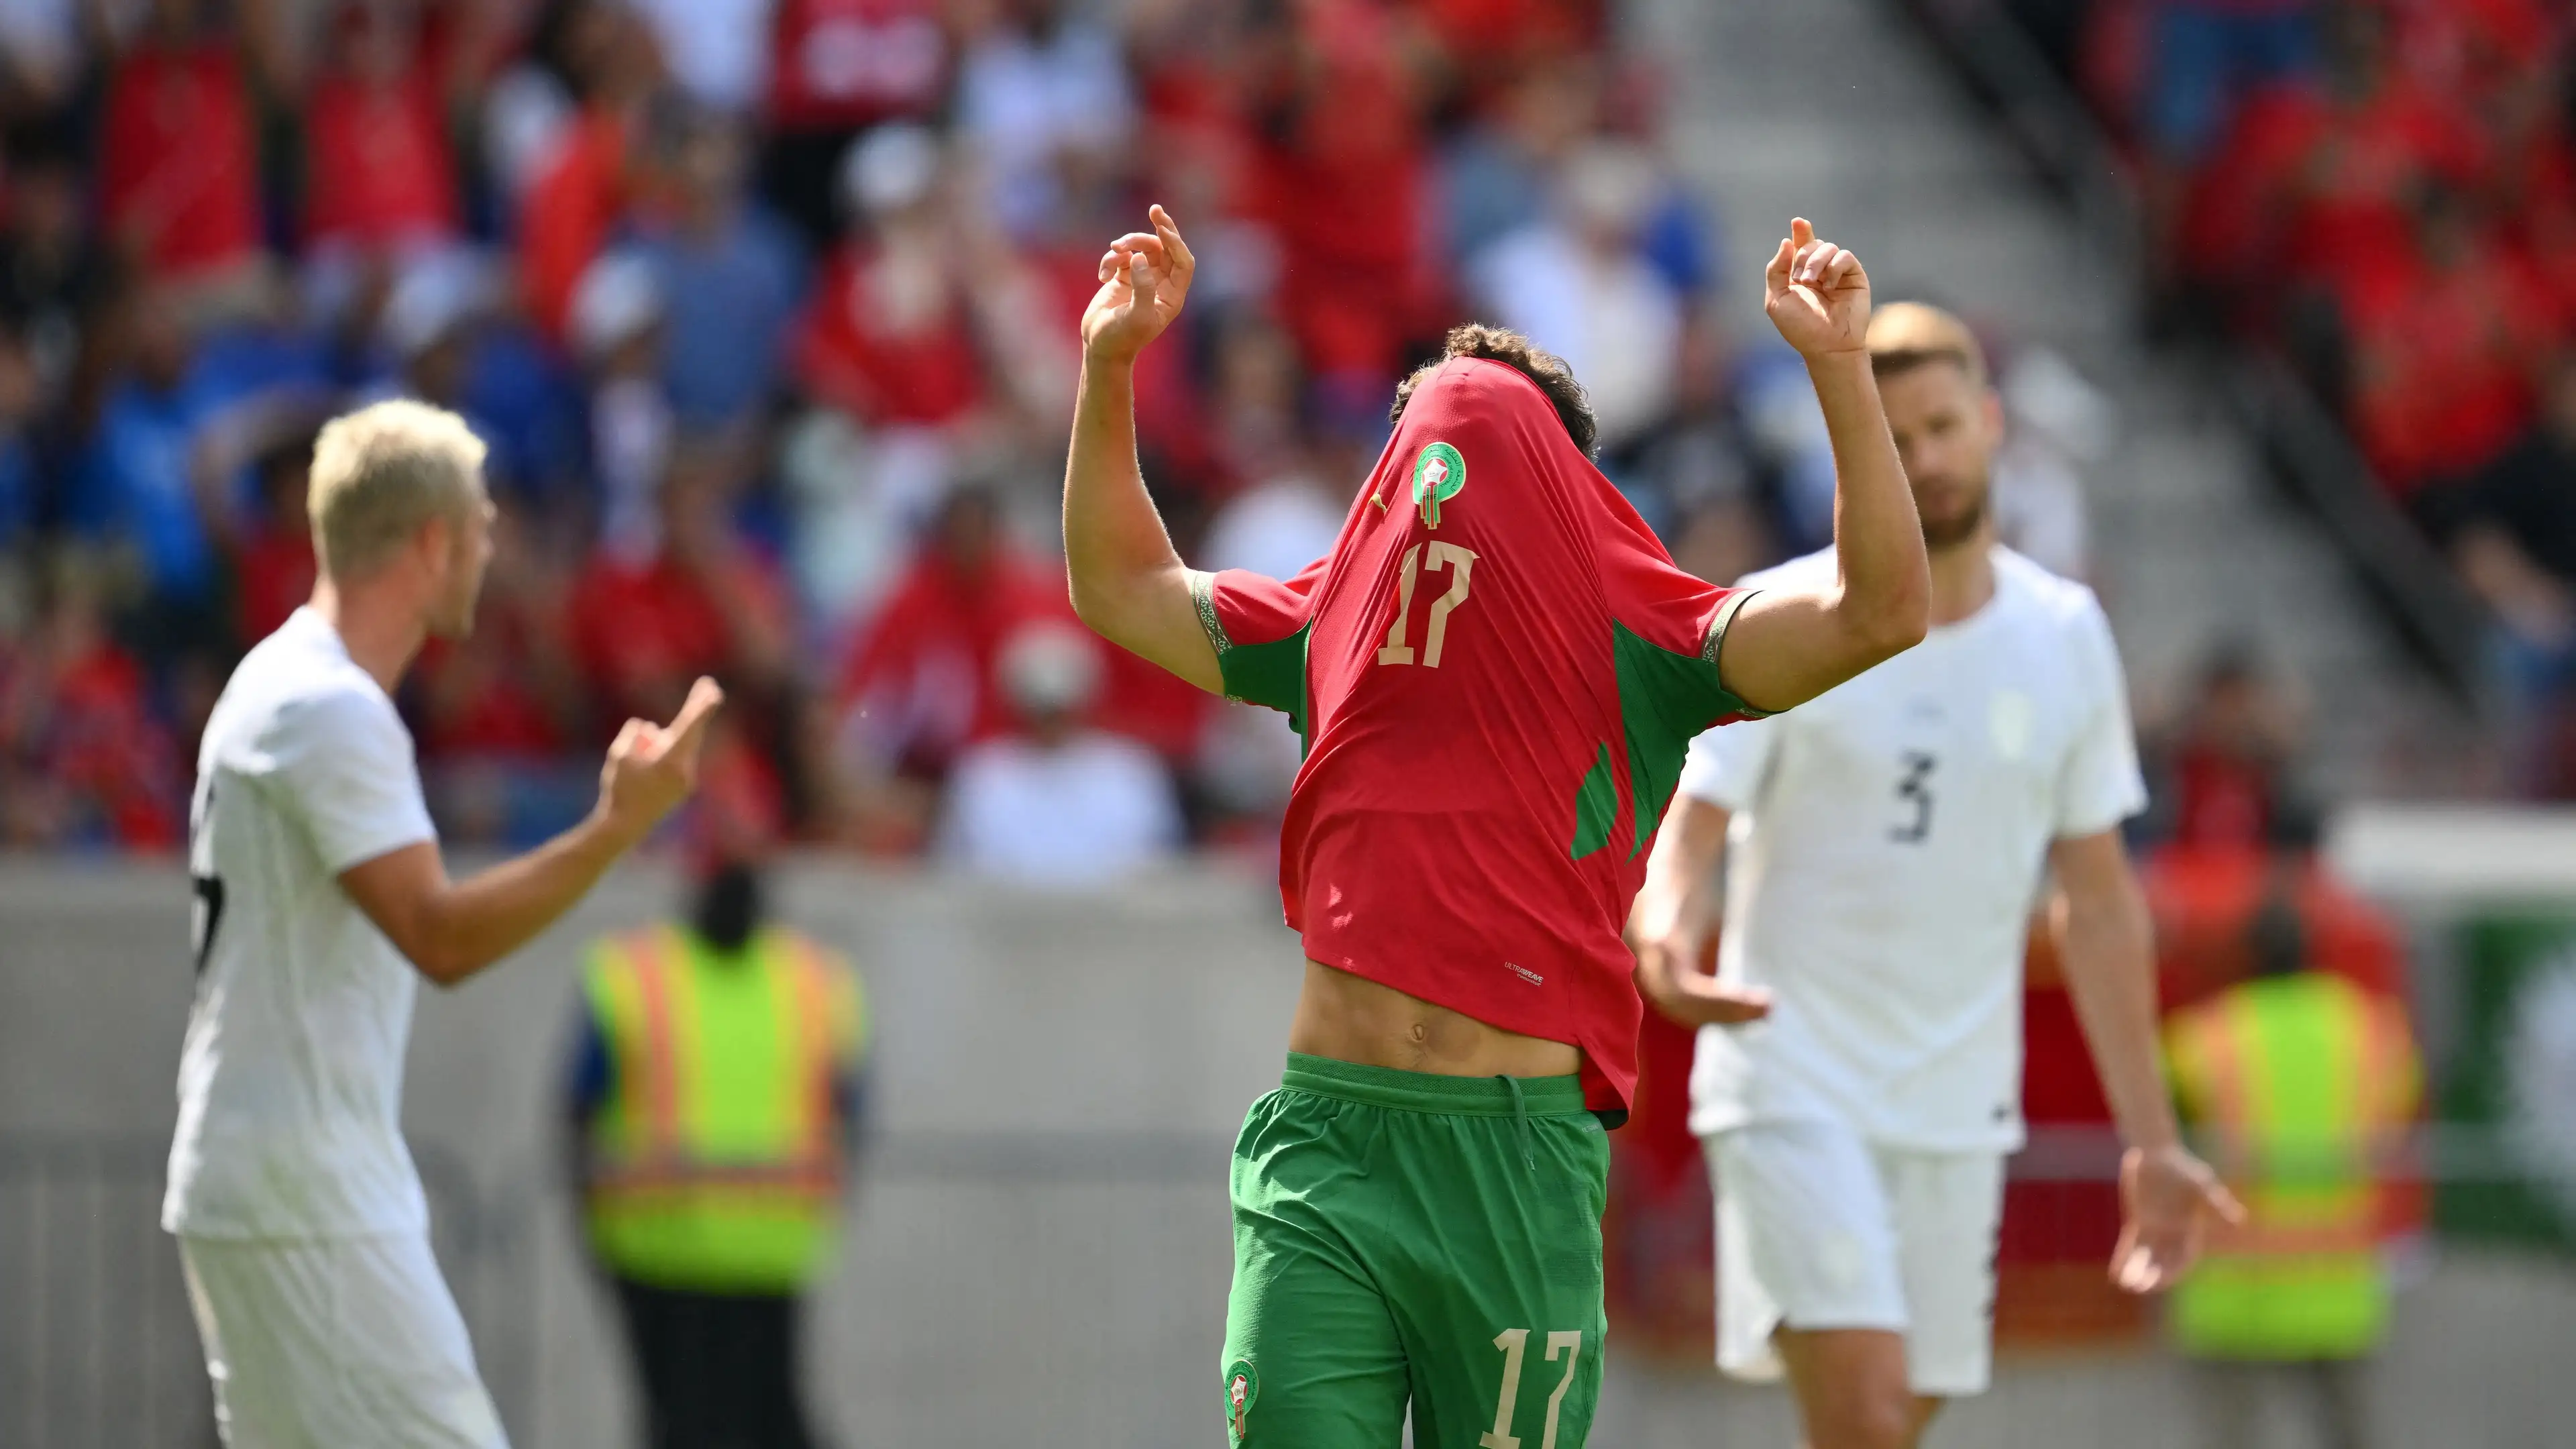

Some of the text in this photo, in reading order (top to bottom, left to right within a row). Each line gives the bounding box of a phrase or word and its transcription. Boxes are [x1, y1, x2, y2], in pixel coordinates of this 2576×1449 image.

[1378, 540, 1481, 668] 17
[1888, 748, 1937, 843] 3
[1504, 961, 1544, 983] ULTRAWEAVE
[1479, 1328, 1582, 1449] 17
